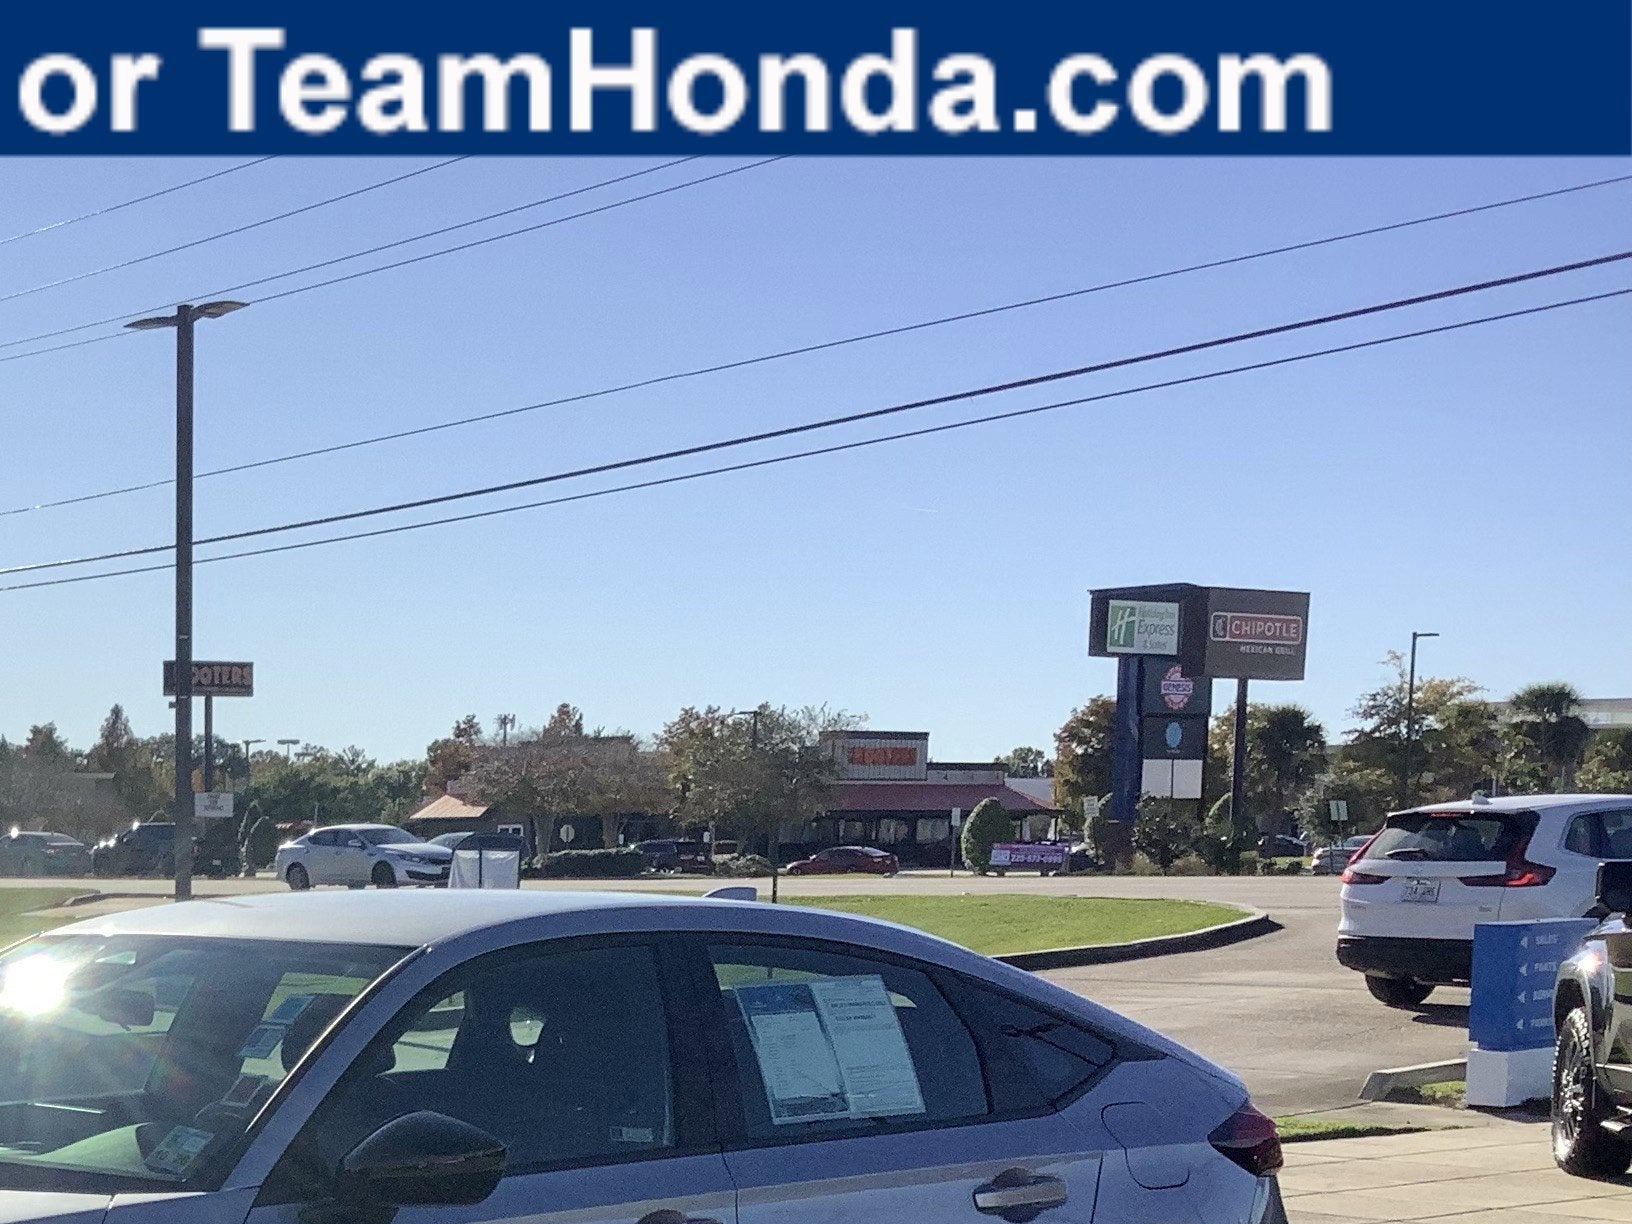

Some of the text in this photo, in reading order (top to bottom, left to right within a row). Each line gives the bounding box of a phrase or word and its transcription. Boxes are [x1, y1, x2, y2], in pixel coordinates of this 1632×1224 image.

[1137, 619, 1175, 638] Express
[1231, 620, 1298, 637] CHIPOTLE
[1239, 645, 1273, 654] MEXICAN
